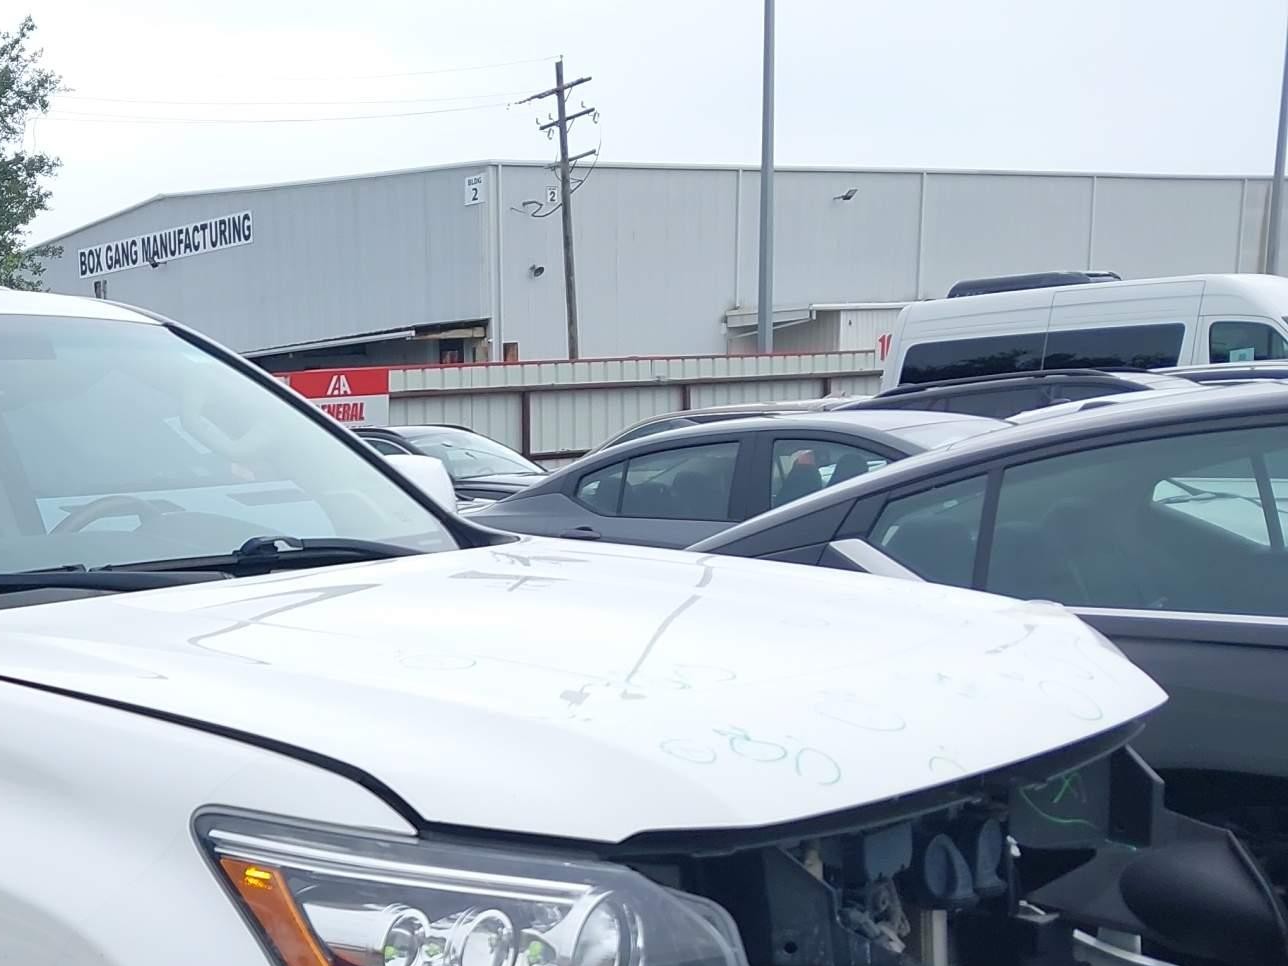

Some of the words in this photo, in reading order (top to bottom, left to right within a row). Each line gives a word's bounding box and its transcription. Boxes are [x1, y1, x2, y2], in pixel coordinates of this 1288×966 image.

[471, 188, 479, 202] 2
[549, 190, 556, 202] 2
[79, 247, 104, 276] BOX
[105, 239, 139, 271] GANG
[141, 213, 252, 263] MANUFACTURING
[318, 402, 365, 422] NERAL
